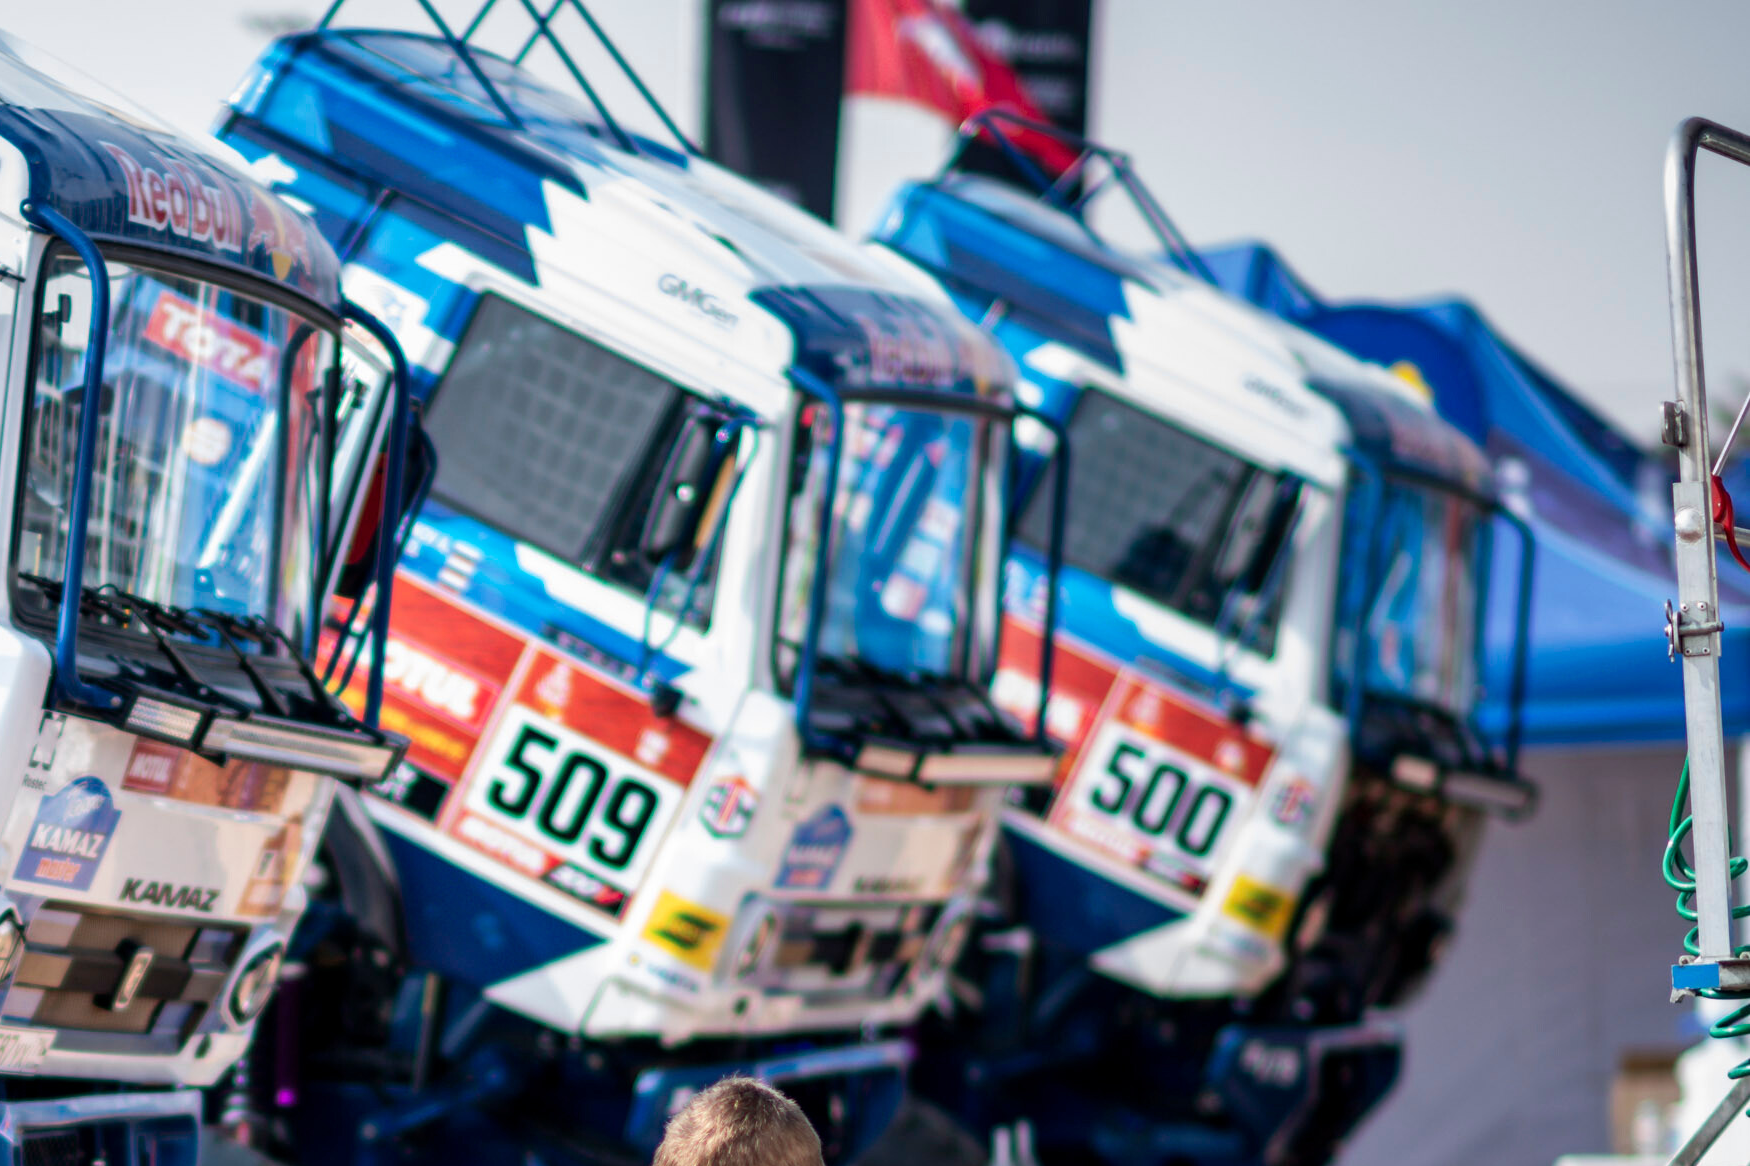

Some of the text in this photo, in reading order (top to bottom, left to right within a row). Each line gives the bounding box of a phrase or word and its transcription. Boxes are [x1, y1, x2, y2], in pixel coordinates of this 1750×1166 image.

[162, 302, 270, 380] TOTA
[487, 722, 662, 872] 509
[1090, 739, 1234, 860] 500
[31, 822, 106, 859] KAMAZ
[118, 876, 220, 913] KAMAZ
